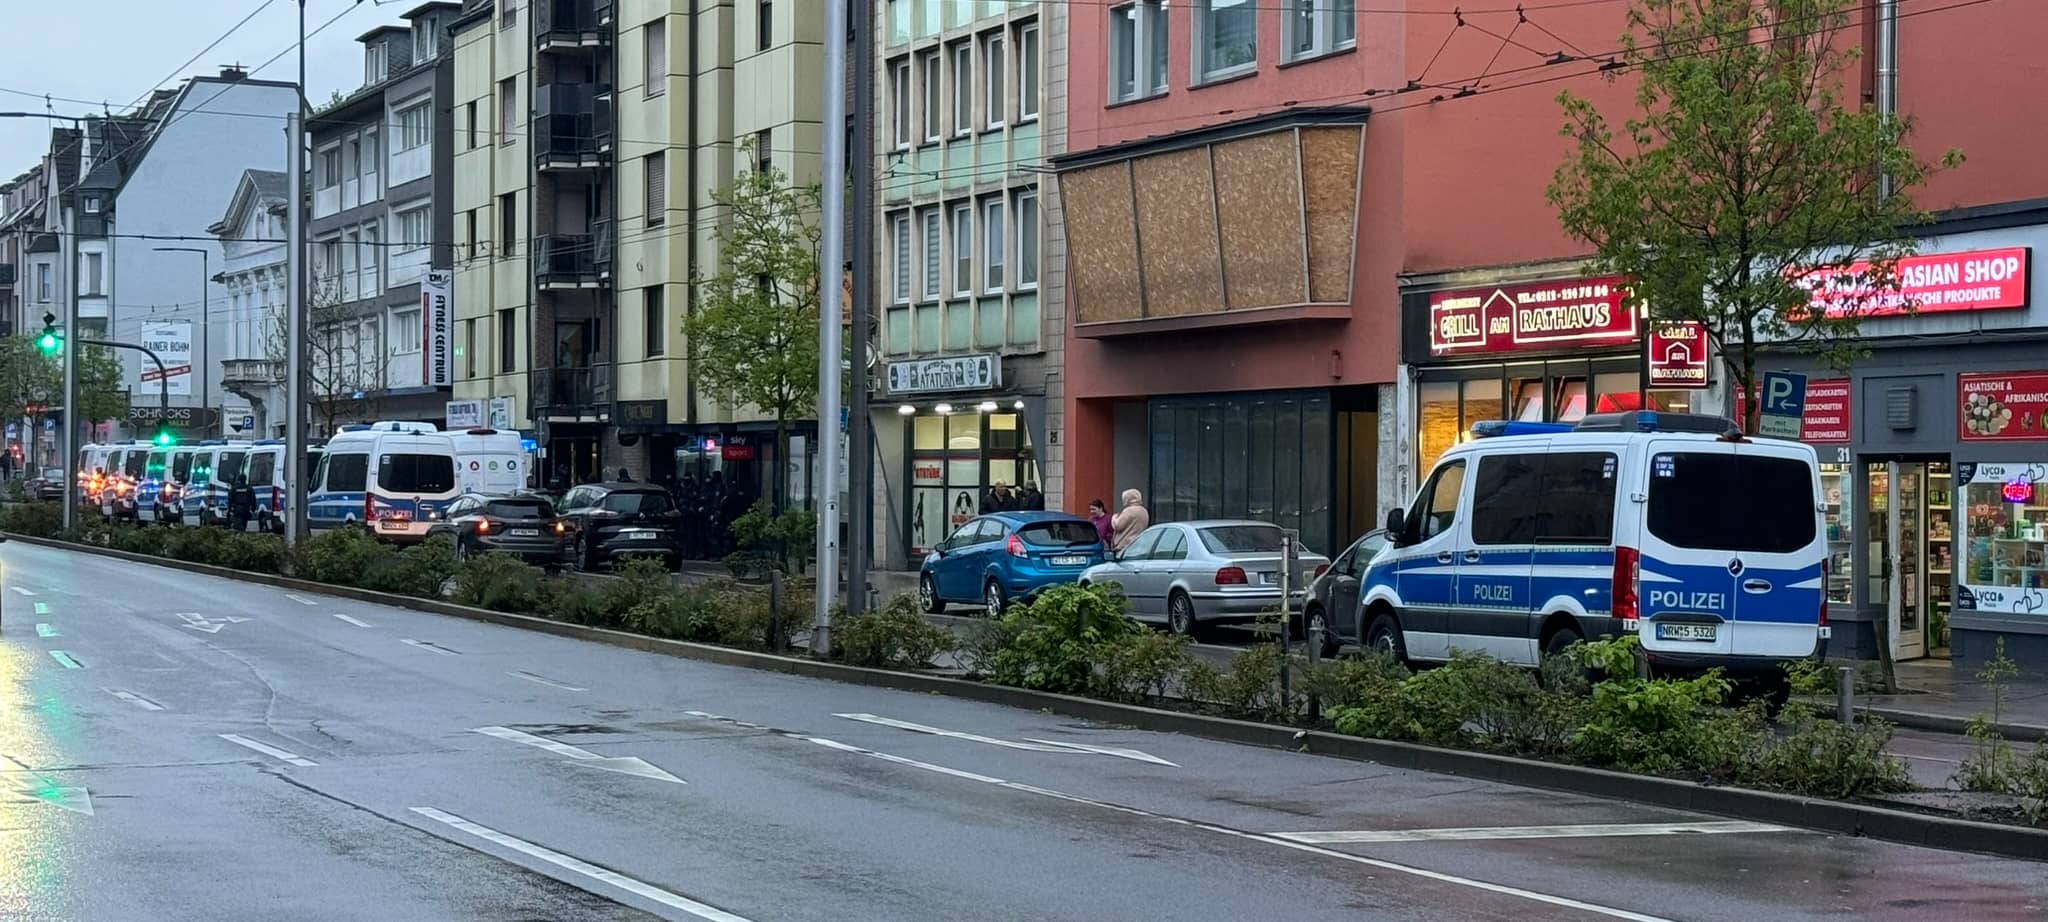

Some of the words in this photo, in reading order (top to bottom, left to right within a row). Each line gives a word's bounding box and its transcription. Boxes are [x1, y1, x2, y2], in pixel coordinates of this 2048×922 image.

[1902, 262, 1959, 288] ASIAN
[1965, 256, 2019, 283] SHOP
[1944, 286, 2001, 303] PRODUKTE
[435, 294, 446, 332] FITNESS
[1440, 313, 1480, 338] GRILL
[1490, 317, 1511, 334] AM
[1519, 303, 1611, 332] RATHAUS
[435, 334, 446, 384] CENTRUM
[1767, 377, 1793, 409] P
[1964, 381, 2005, 392] ASIATISCHE
[2006, 381, 2013, 391] &
[730, 436, 747, 445] sky
[1837, 448, 1850, 462] 31
[1981, 465, 2000, 477] Lyca
[2003, 484, 2033, 498] OPEN
[379, 510, 413, 519] POLIZEI
[1474, 584, 1513, 601] POLIZEI
[1650, 590, 1725, 610] POLIZEI
[1974, 588, 1997, 603] Lyca
[1694, 627, 1715, 638] 5320
